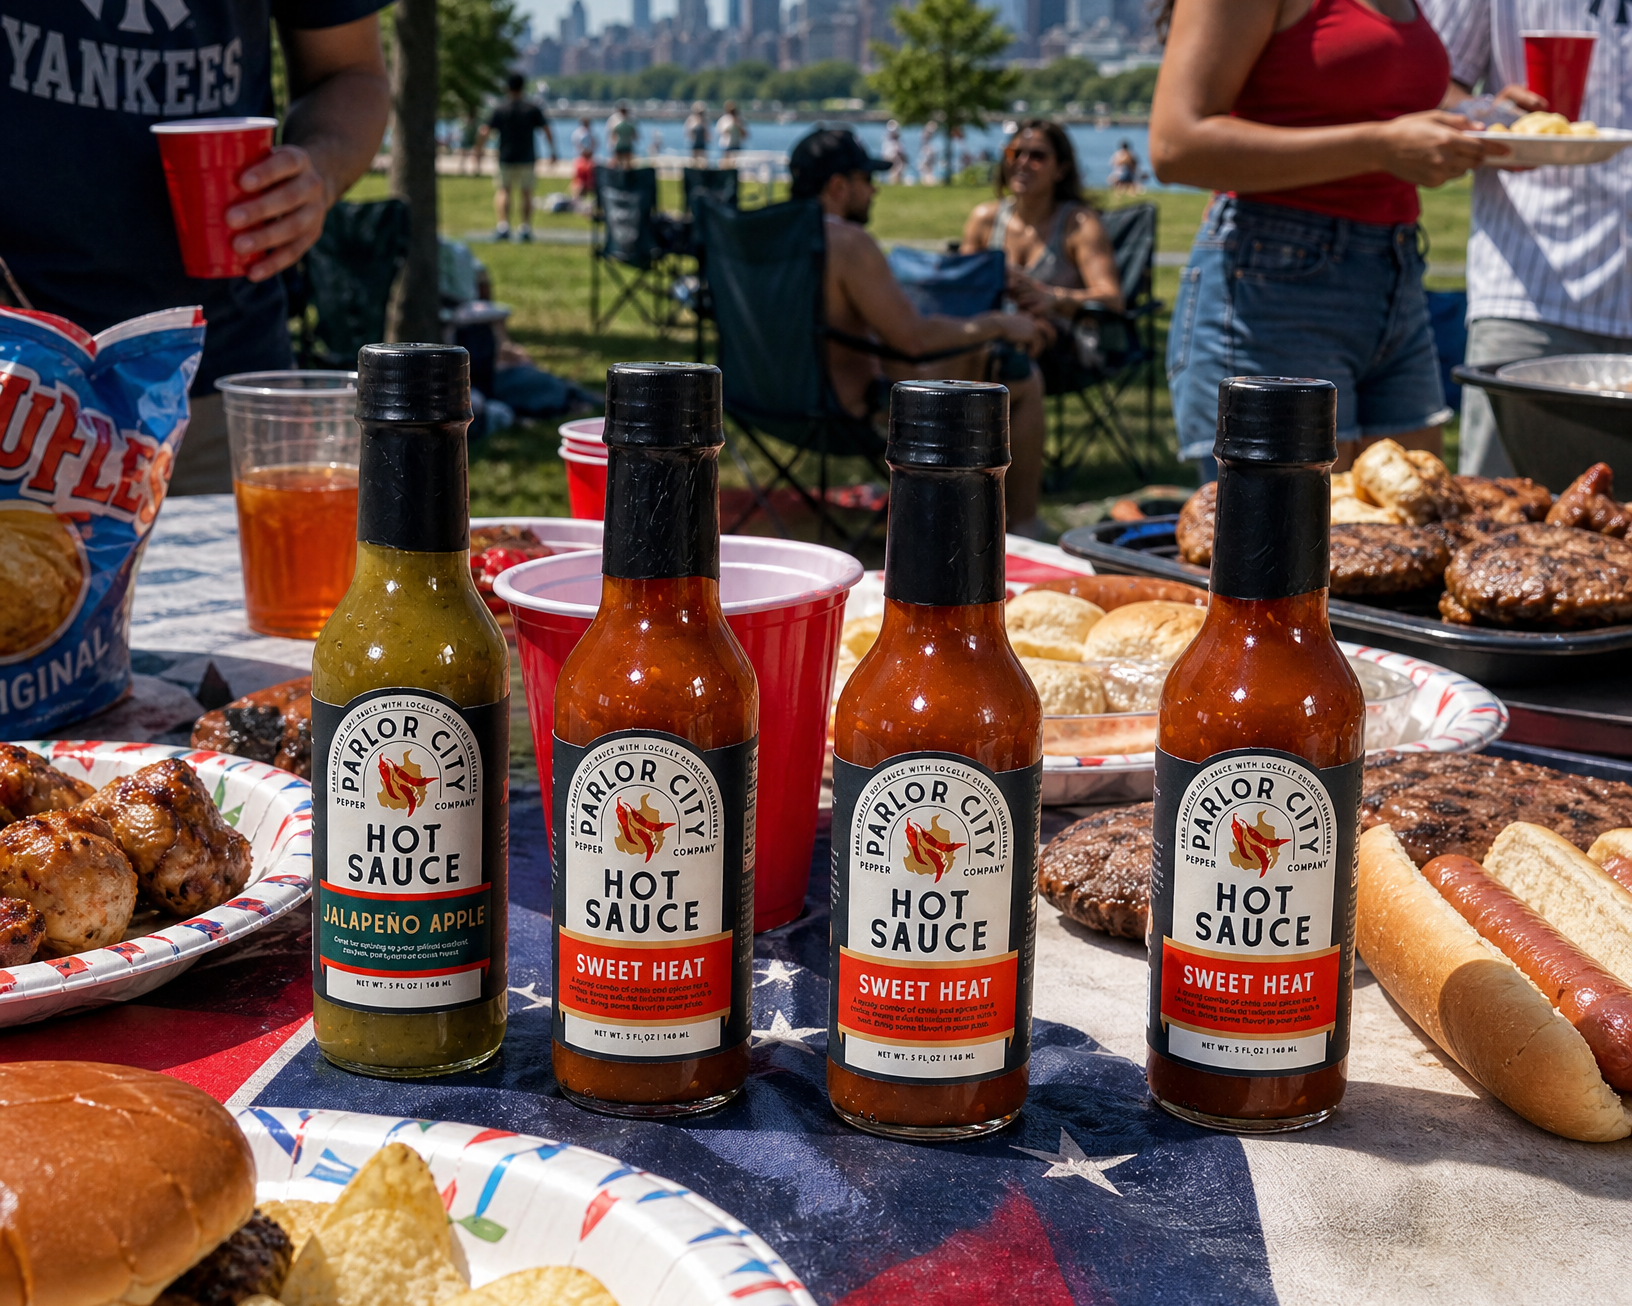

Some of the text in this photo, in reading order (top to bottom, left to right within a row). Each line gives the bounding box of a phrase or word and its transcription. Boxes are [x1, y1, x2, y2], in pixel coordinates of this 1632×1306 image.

[2, 14, 242, 116] YANKEES
[381, 701, 402, 709] WITH
[342, 716, 419, 792] PARLOR
[431, 730, 466, 792] CITY
[618, 744, 639, 752] WITH
[909, 765, 930, 773] WITH
[336, 797, 476, 810] PEPPER COMPANY
[581, 759, 657, 836] PARLOR
[669, 774, 705, 838] CITY
[866, 780, 948, 856] PARLOR
[960, 795, 995, 858] CITY
[1192, 776, 1274, 851] PARLOR
[1286, 792, 1319, 854] CITY
[367, 823, 442, 854] HOT
[575, 841, 716, 857] PEPPER COMPANY
[348, 853, 460, 886] SAUCE
[860, 861, 1005, 877] PEPPER COMPANY
[1186, 854, 1328, 872] PEPPER COMPANY
[604, 868, 680, 900] HOT
[1217, 882, 1294, 914] HOT
[324, 904, 484, 934] JALAPEÑO APPLE
[586, 899, 699, 933] SAUCE
[891, 888, 969, 920] HOT
[871, 919, 988, 953] SAUCE
[1195, 912, 1310, 947] SAUCE
[576, 953, 705, 981] SWEET HEAT
[1184, 965, 1314, 995] SWEET HEAT
[356, 979, 369, 987] NET
[859, 973, 992, 1001] SWEET HEAT
[594, 1029, 607, 1037] NET
[1202, 1042, 1215, 1050] NET
[1218, 1044, 1232, 1052] WT.
[878, 1050, 891, 1058] NET
[930, 1054, 940, 1062] OZ
